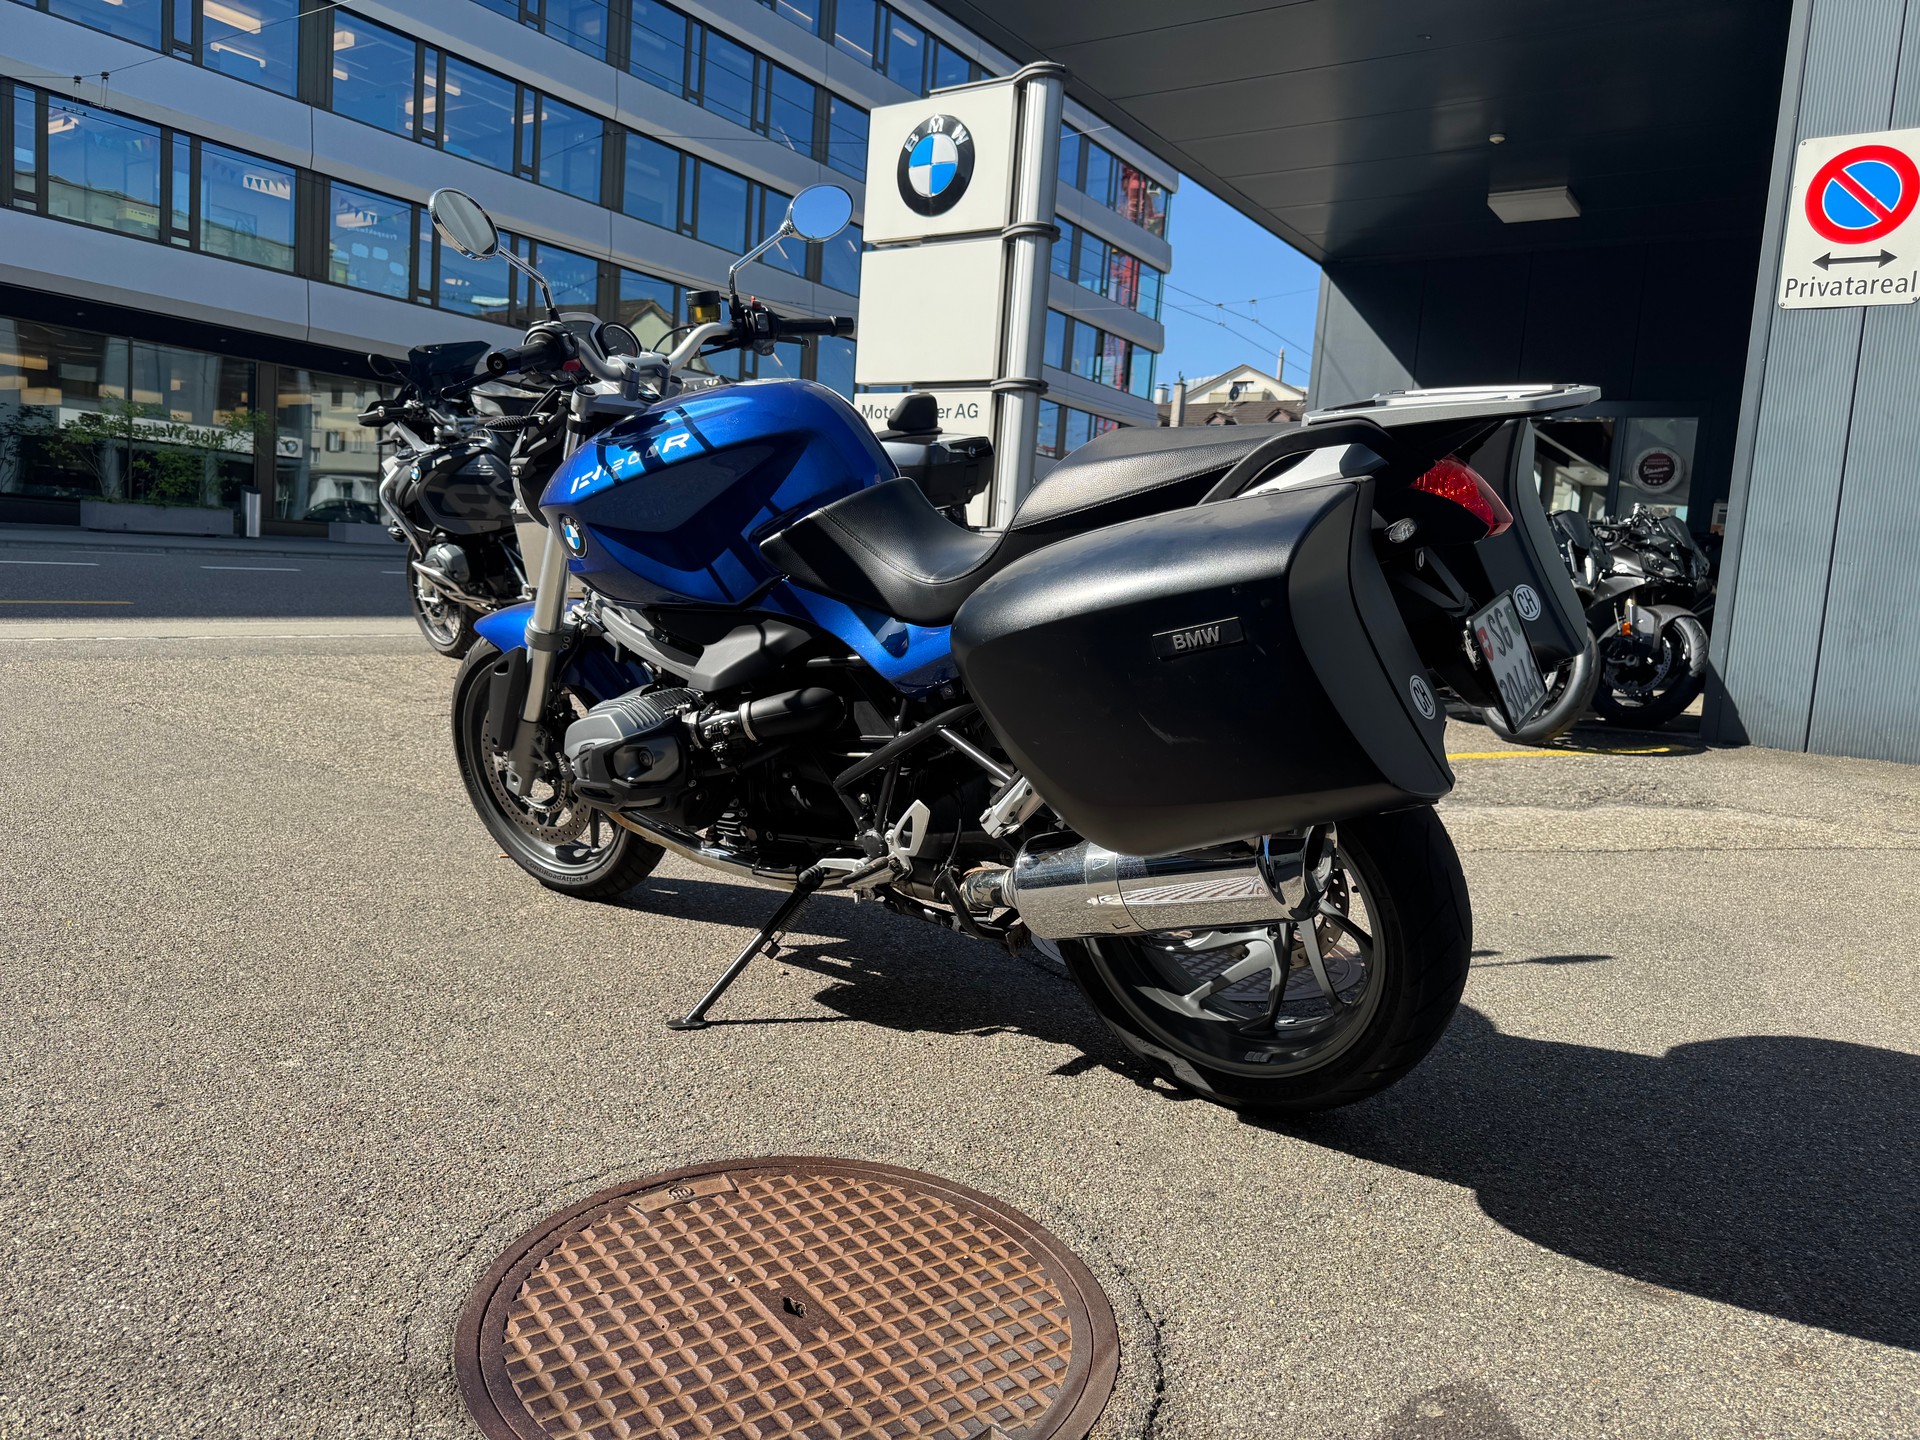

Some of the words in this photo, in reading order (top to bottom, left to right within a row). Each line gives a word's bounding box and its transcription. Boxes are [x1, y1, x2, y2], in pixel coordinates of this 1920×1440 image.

[904, 113, 969, 152] BMW
[1785, 270, 1918, 298] Privatareal
[955, 402, 979, 419] AG
[1517, 589, 1538, 615] CH
[1172, 626, 1219, 650] BMW
[1486, 607, 1514, 657] SG
[1413, 681, 1433, 713] CH
[555, 751, 568, 772] BMW
